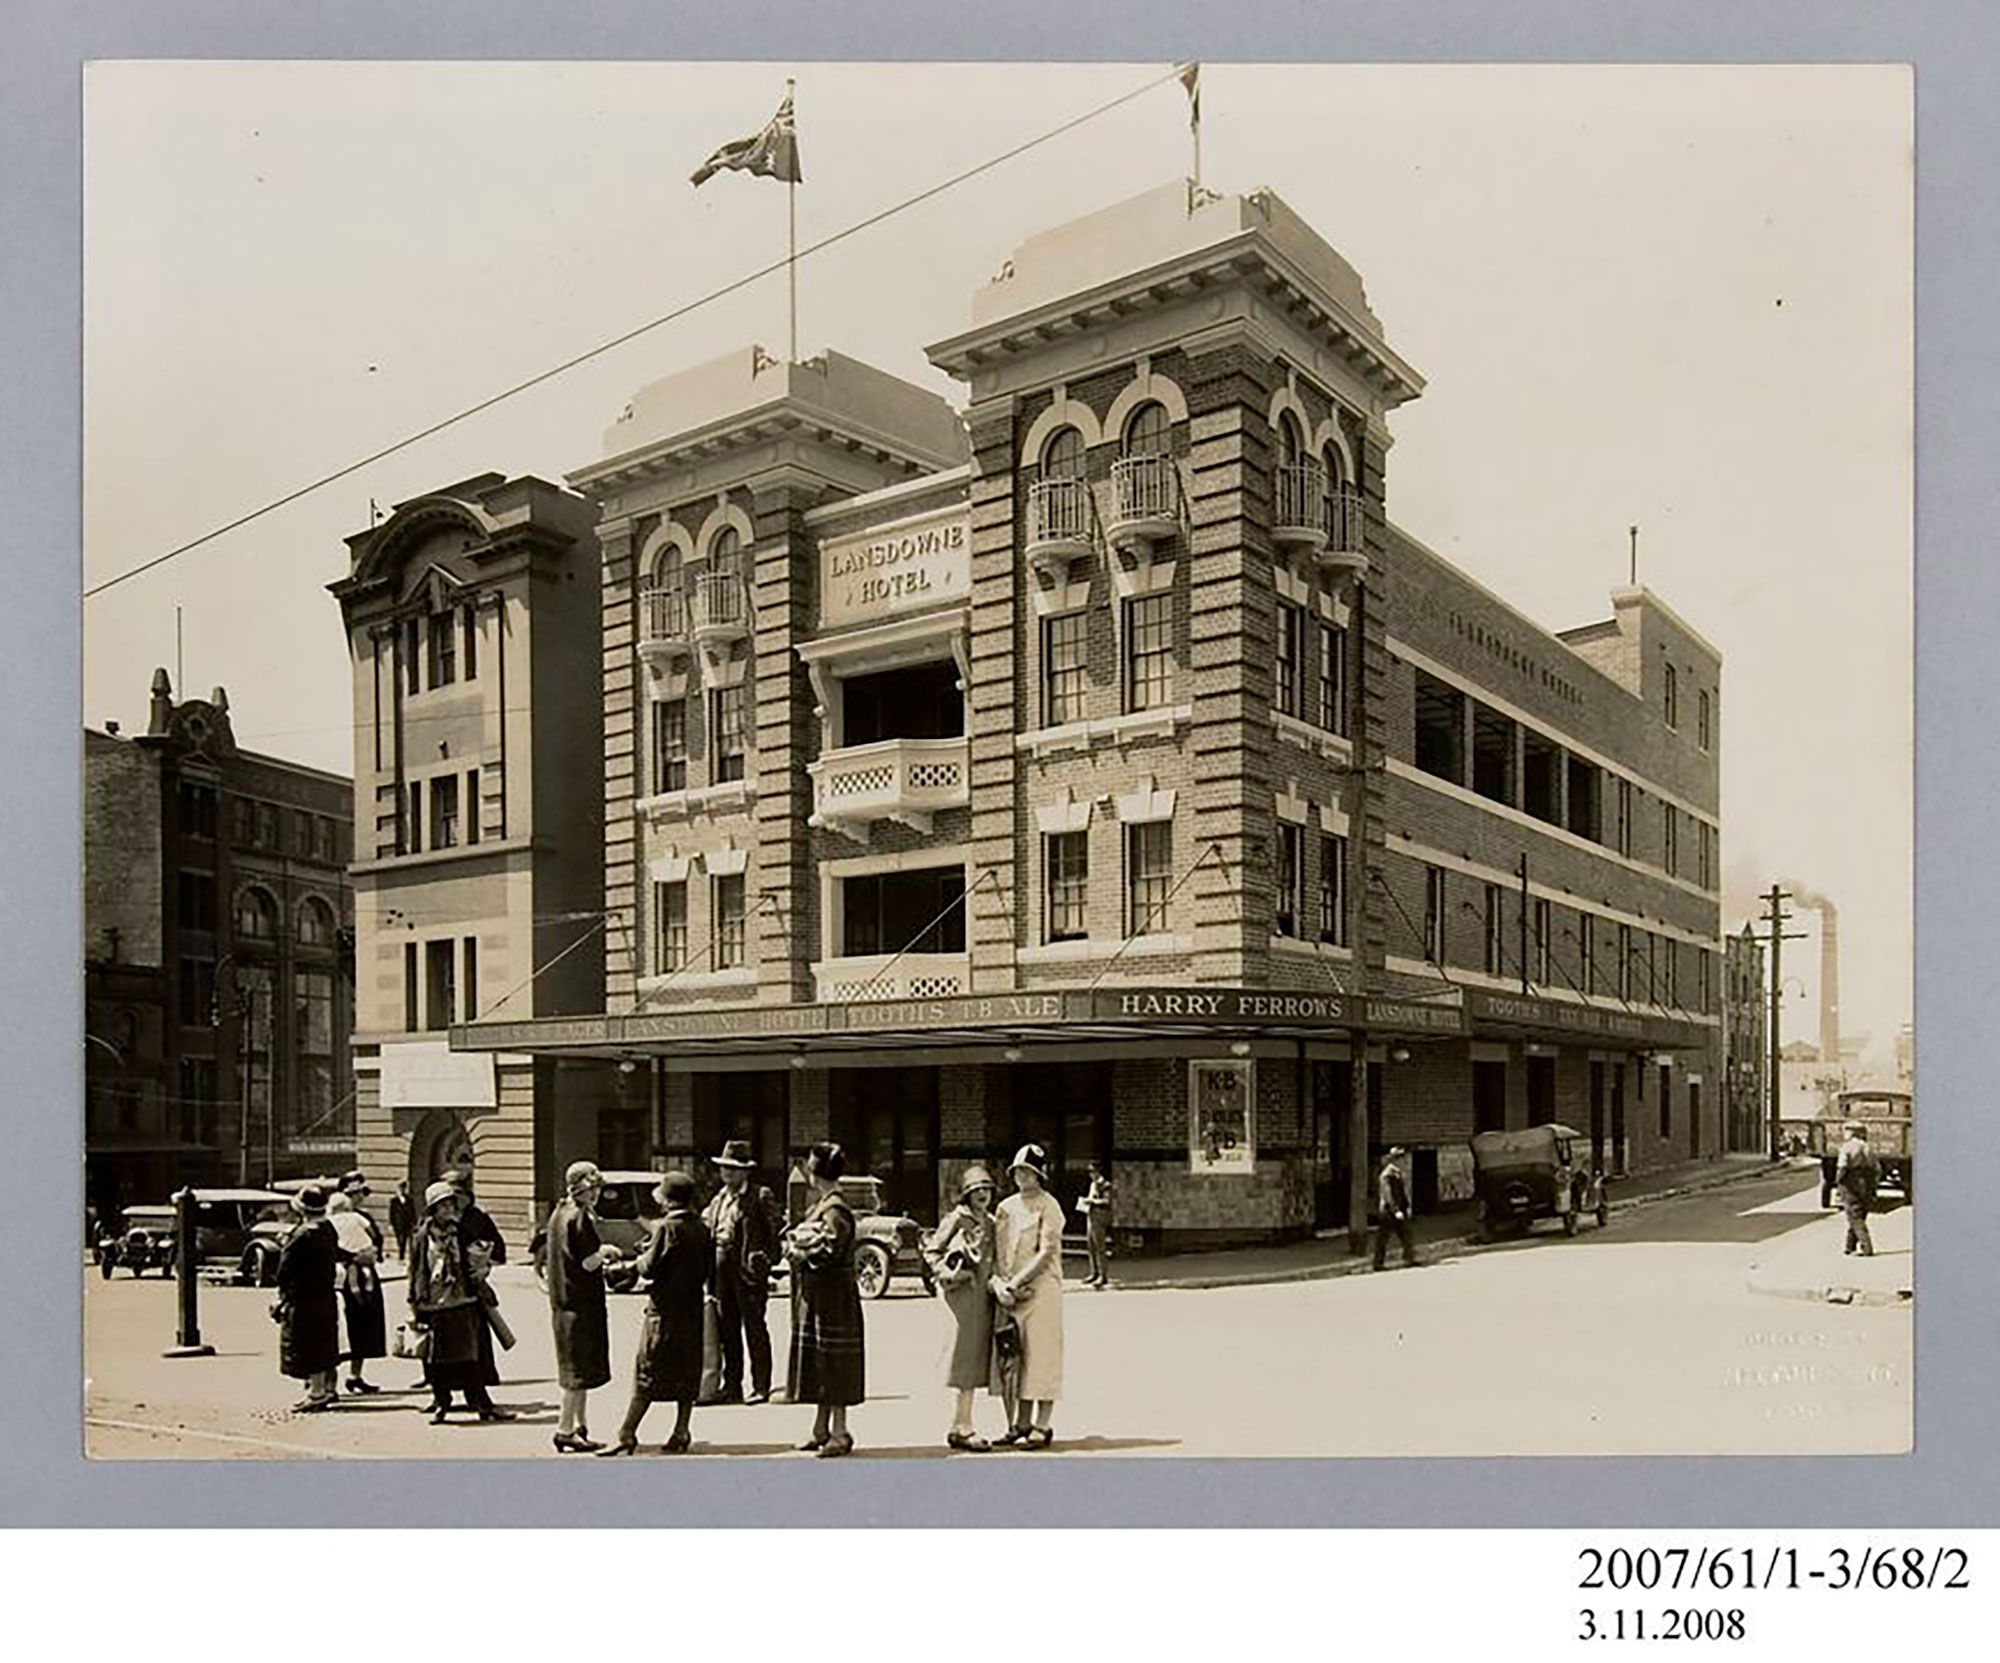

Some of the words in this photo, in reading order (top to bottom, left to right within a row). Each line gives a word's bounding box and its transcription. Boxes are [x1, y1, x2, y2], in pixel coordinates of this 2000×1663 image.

[831, 526, 964, 579] LANSDOWNE
[861, 568, 931, 605] HOTEL
[1003, 996, 1058, 1017] ALE
[1121, 994, 1224, 1015] HARRY
